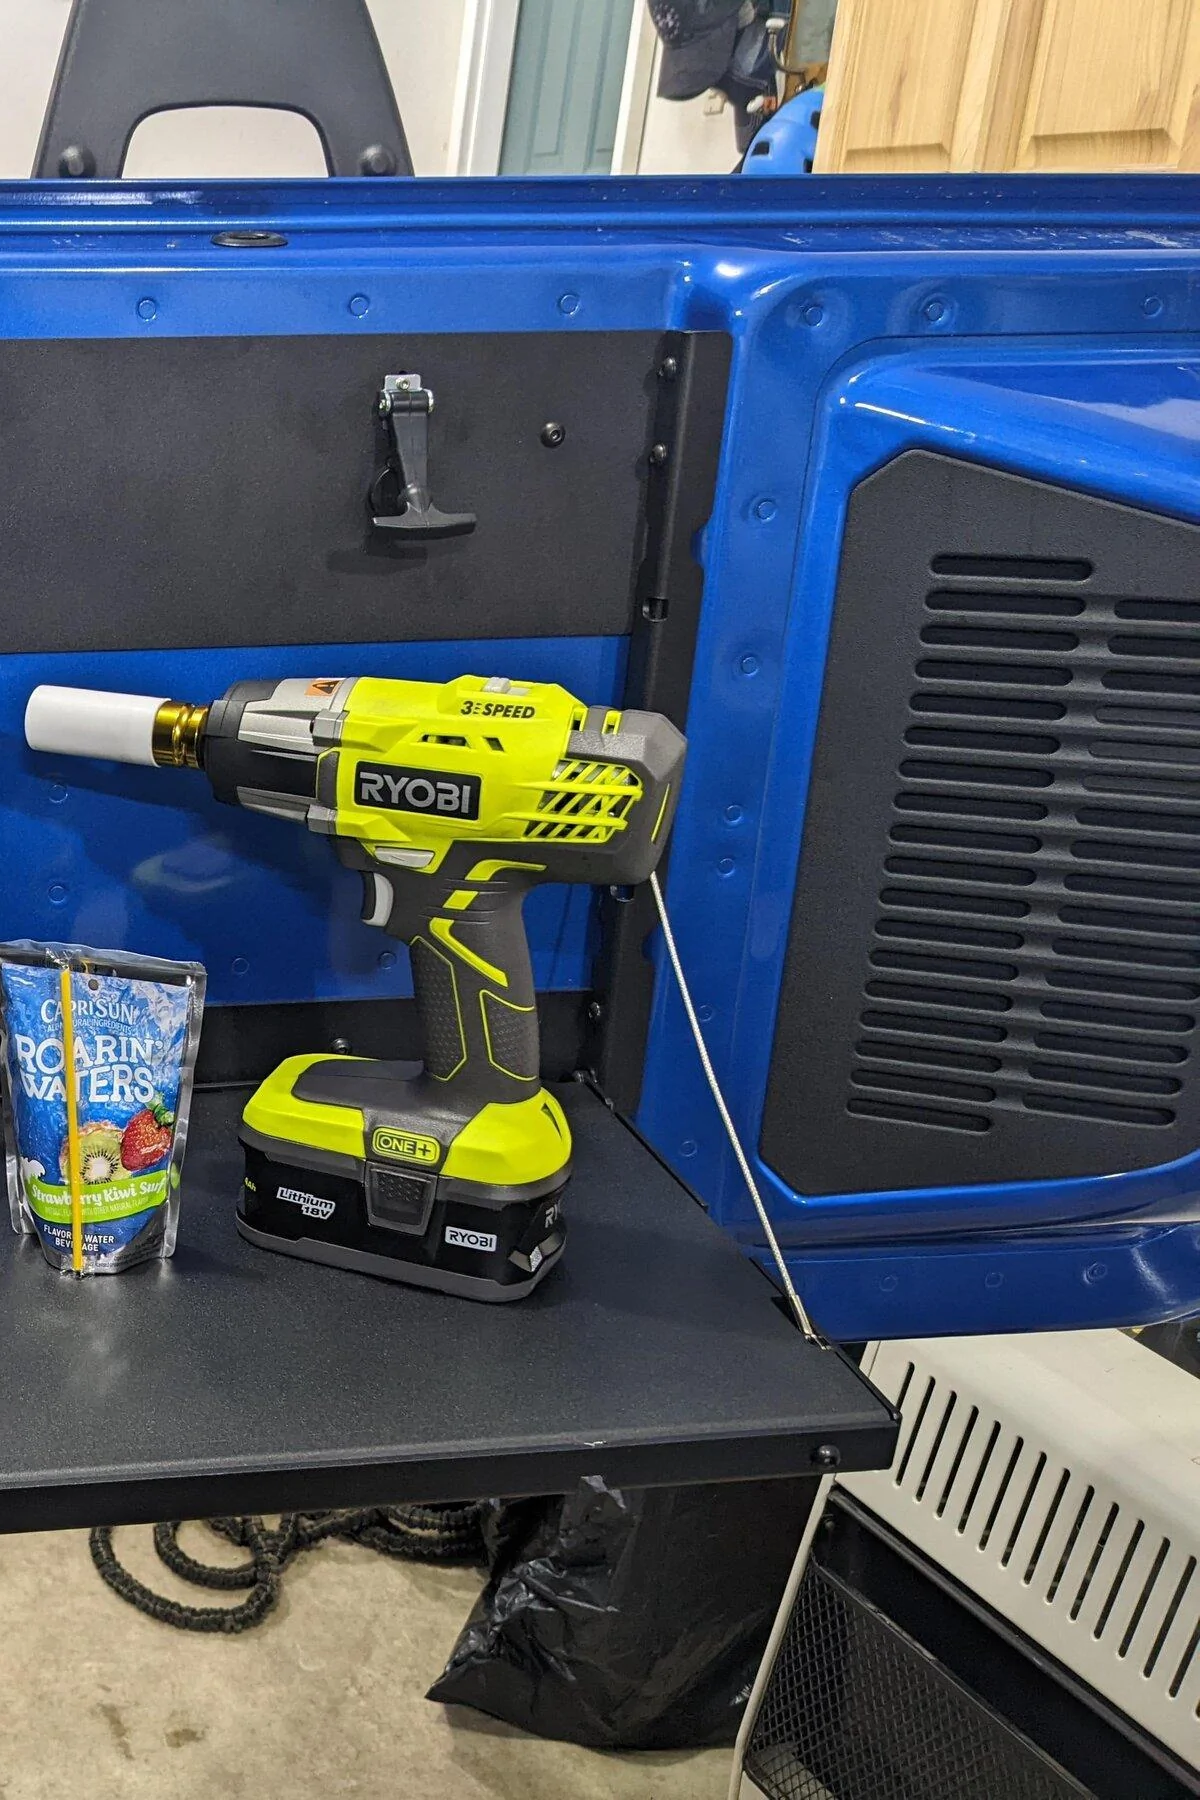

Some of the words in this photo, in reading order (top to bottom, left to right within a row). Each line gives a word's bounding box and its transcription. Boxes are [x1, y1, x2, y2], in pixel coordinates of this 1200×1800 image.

[360, 771, 471, 814] RYOBI
[20, 1065, 155, 1104] WATERS
[380, 1136, 431, 1157] ONE+
[32, 1184, 103, 1207] Strawbrry
[104, 1183, 138, 1204] Kiwi
[139, 1176, 167, 1196] Surf
[278, 1188, 335, 1211] Lithium
[302, 1203, 331, 1219] 18V
[43, 1224, 83, 1240] FLAVOR
[85, 1234, 115, 1244] WATER
[55, 1237, 99, 1252] BEVAGE
[448, 1229, 494, 1249] RYOBI
